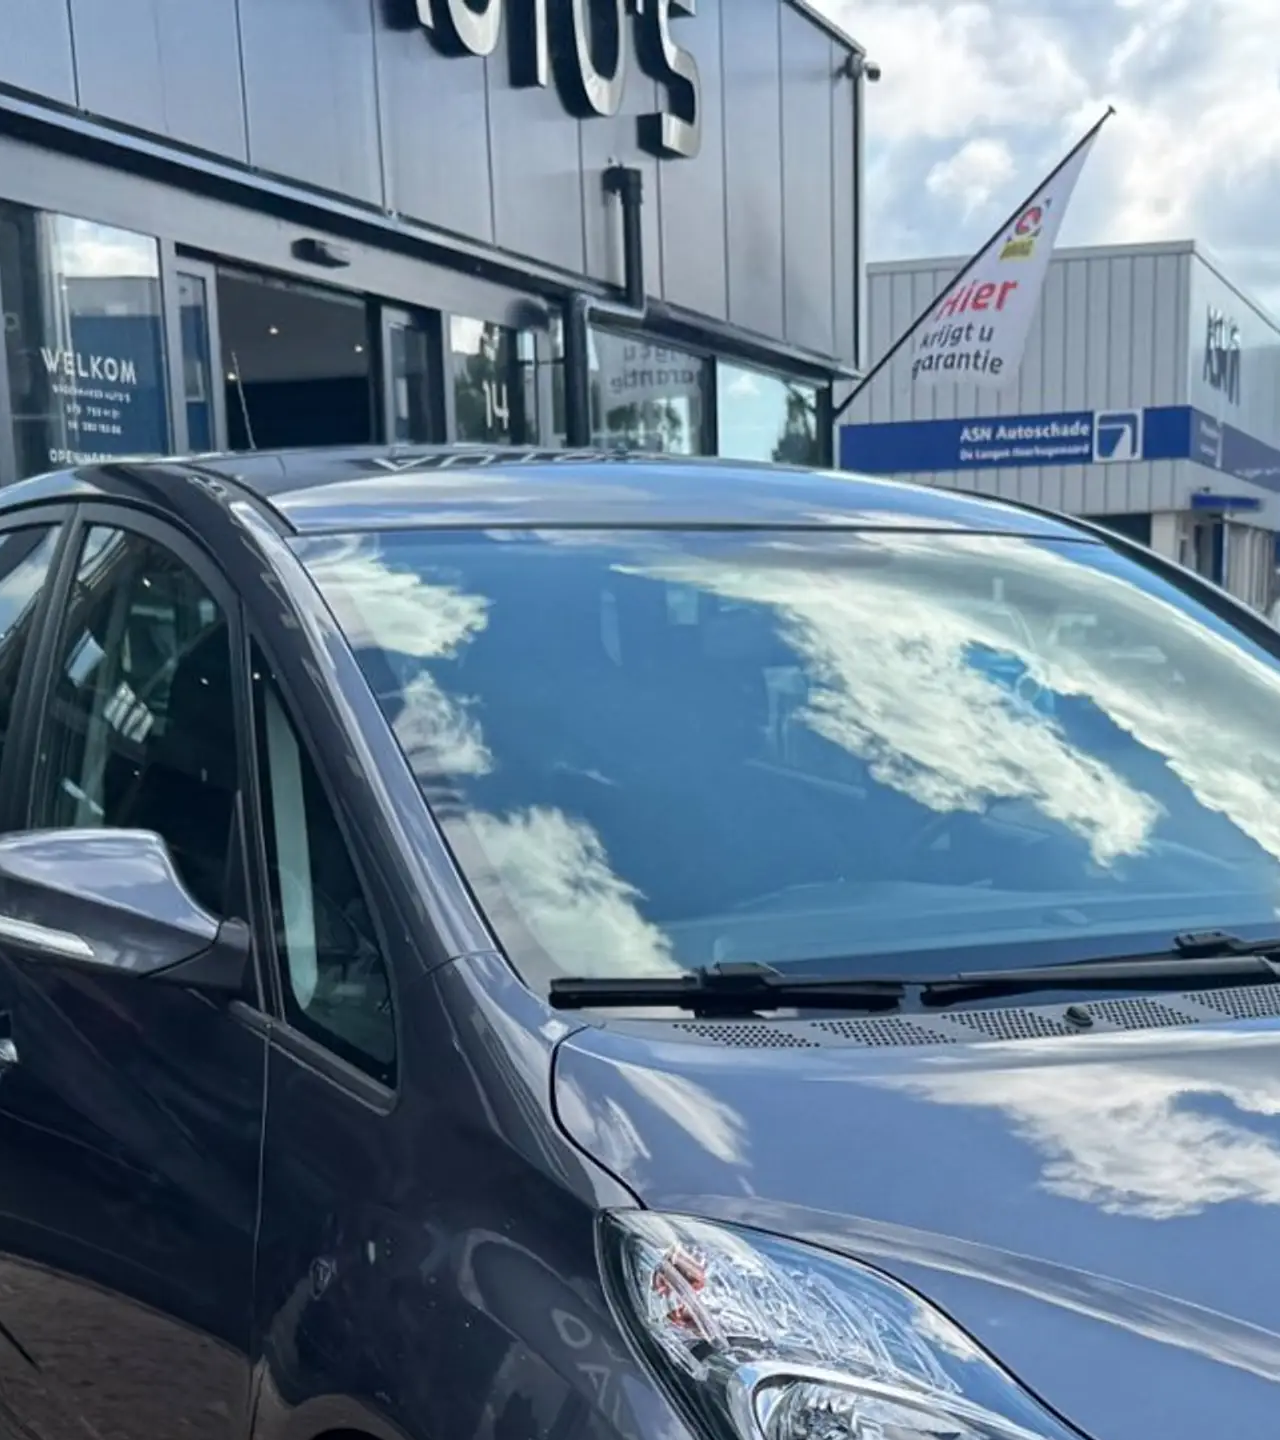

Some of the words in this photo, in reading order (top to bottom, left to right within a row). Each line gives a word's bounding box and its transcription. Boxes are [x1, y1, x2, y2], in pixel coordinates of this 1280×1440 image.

[933, 279, 1019, 322] Hier
[978, 325, 995, 343] u
[40, 347, 137, 386] WELKOM
[482, 380, 510, 430] 14
[960, 426, 992, 443] ASN
[995, 419, 1091, 441] Autoschade
